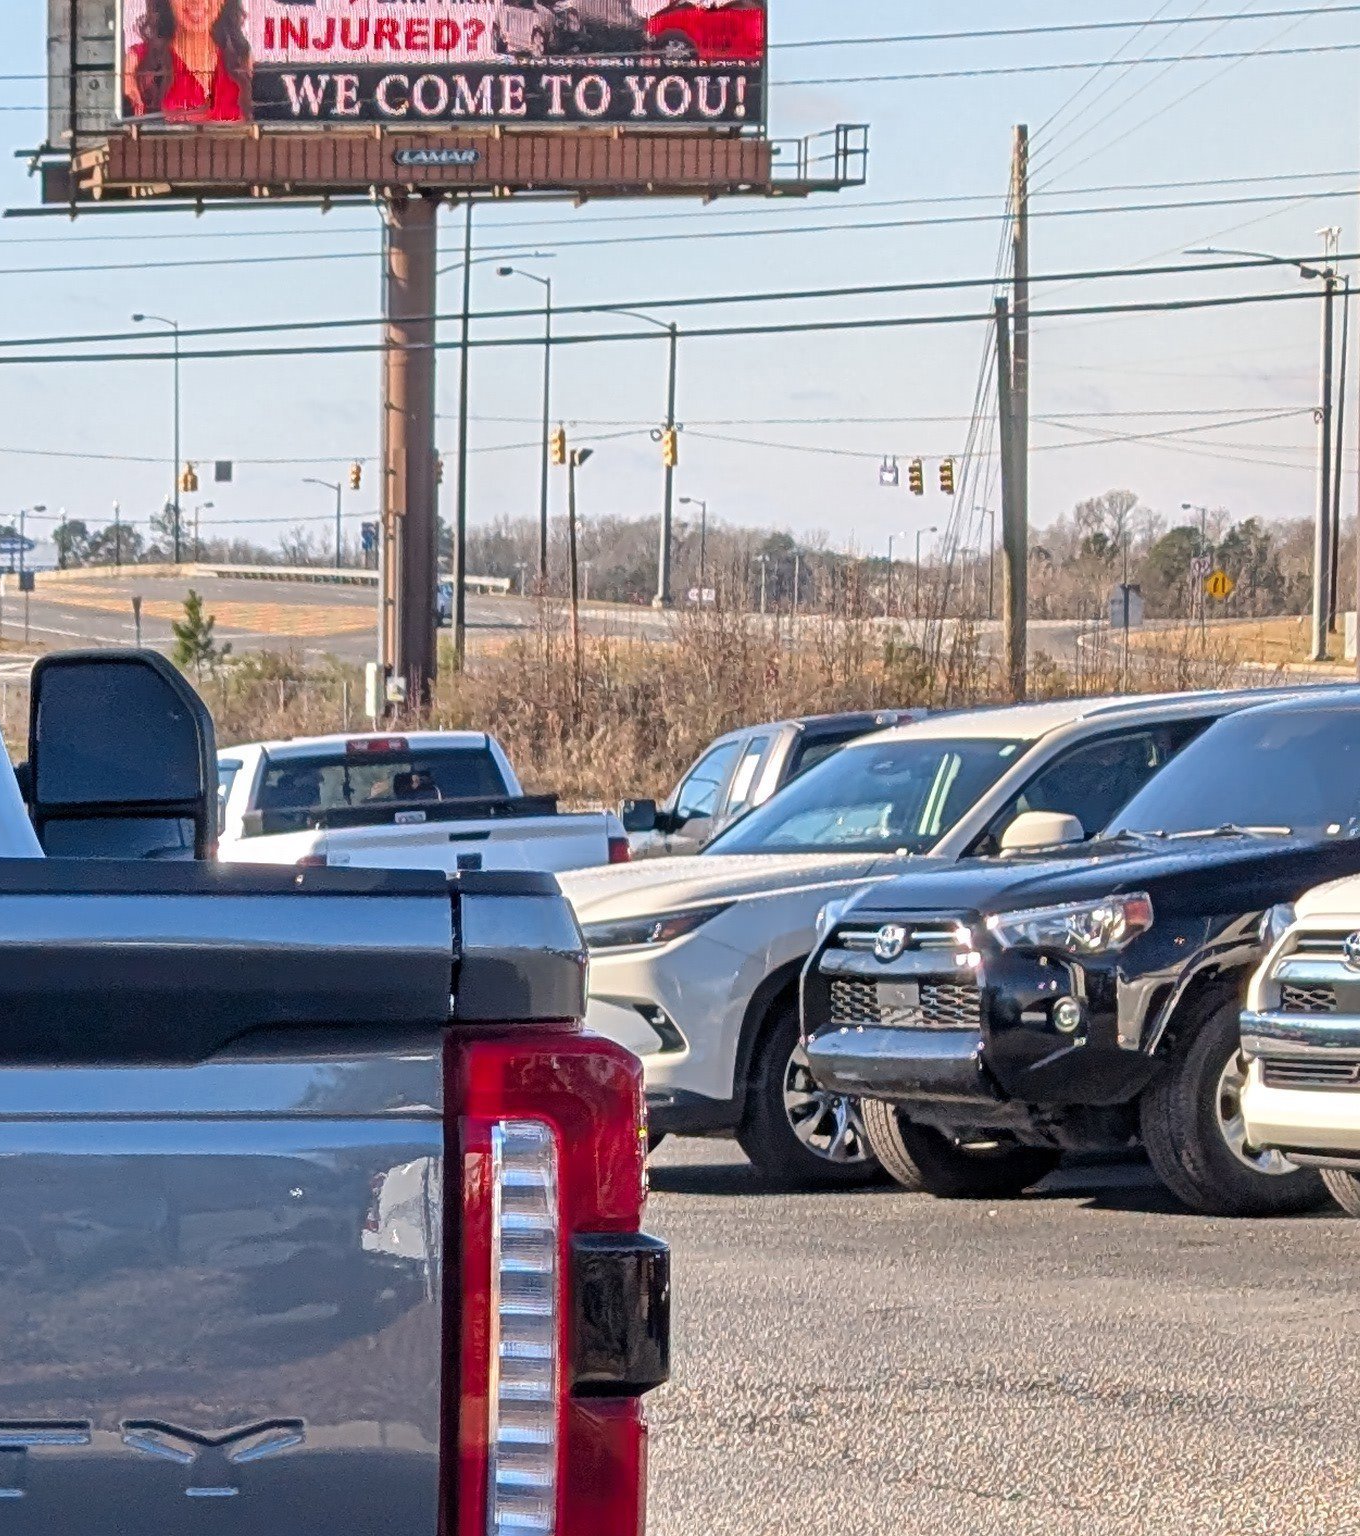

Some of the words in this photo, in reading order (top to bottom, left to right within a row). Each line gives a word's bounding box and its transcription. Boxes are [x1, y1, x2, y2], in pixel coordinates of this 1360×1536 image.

[264, 16, 486, 51] INJURED?
[281, 74, 361, 116] WE
[376, 73, 528, 116] COME
[540, 74, 612, 116] TO
[624, 74, 748, 117] YOU!
[401, 150, 476, 162] LAMAR
